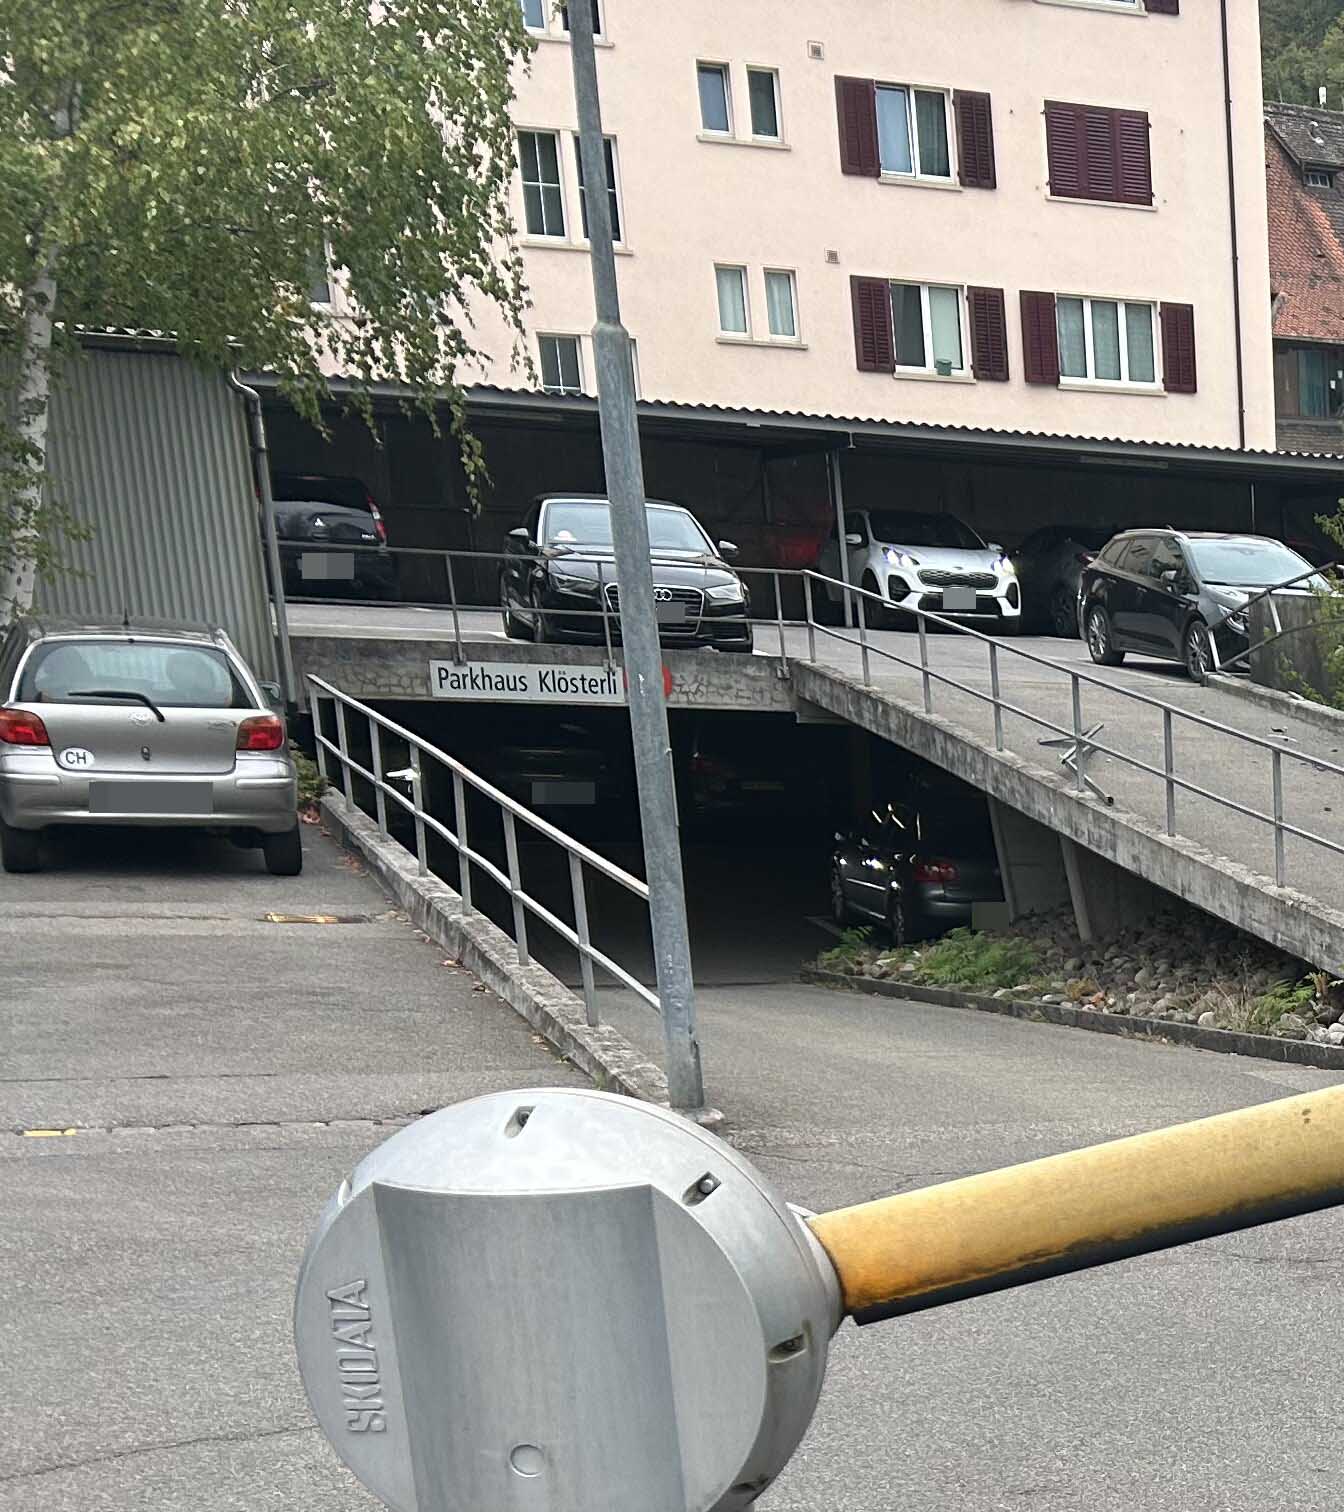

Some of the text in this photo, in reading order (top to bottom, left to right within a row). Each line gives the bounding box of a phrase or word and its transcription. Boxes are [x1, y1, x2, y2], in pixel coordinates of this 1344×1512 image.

[437, 666, 618, 695] Parkhaus Klösterli
[65, 751, 87, 764] CH
[326, 1280, 387, 1433] SKIDATA
